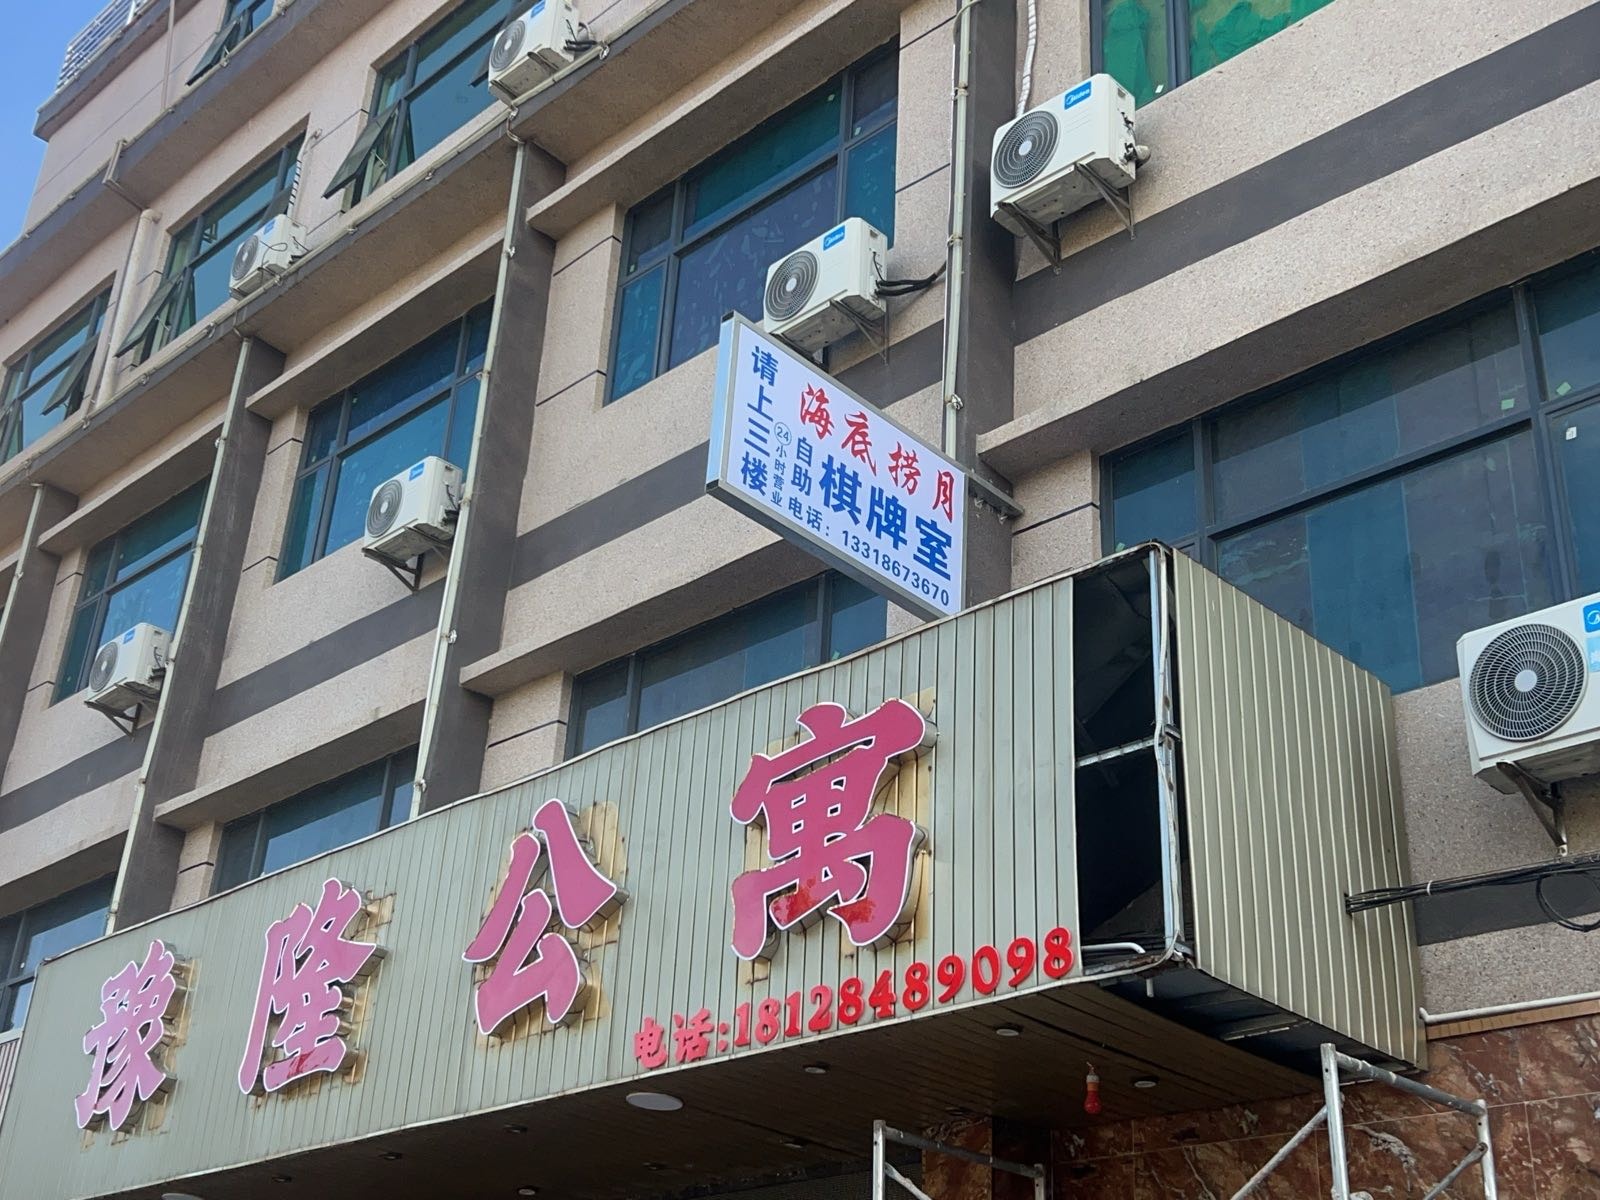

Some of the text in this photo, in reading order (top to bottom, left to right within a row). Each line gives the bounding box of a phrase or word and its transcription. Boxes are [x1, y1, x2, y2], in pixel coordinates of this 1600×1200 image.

[740, 345, 778, 497] 请上三楼
[791, 436, 813, 496] 自助
[799, 383, 955, 523] 海底捞月
[819, 454, 951, 581] 棋牌室
[75, 697, 933, 1130] 豫隆公寓
